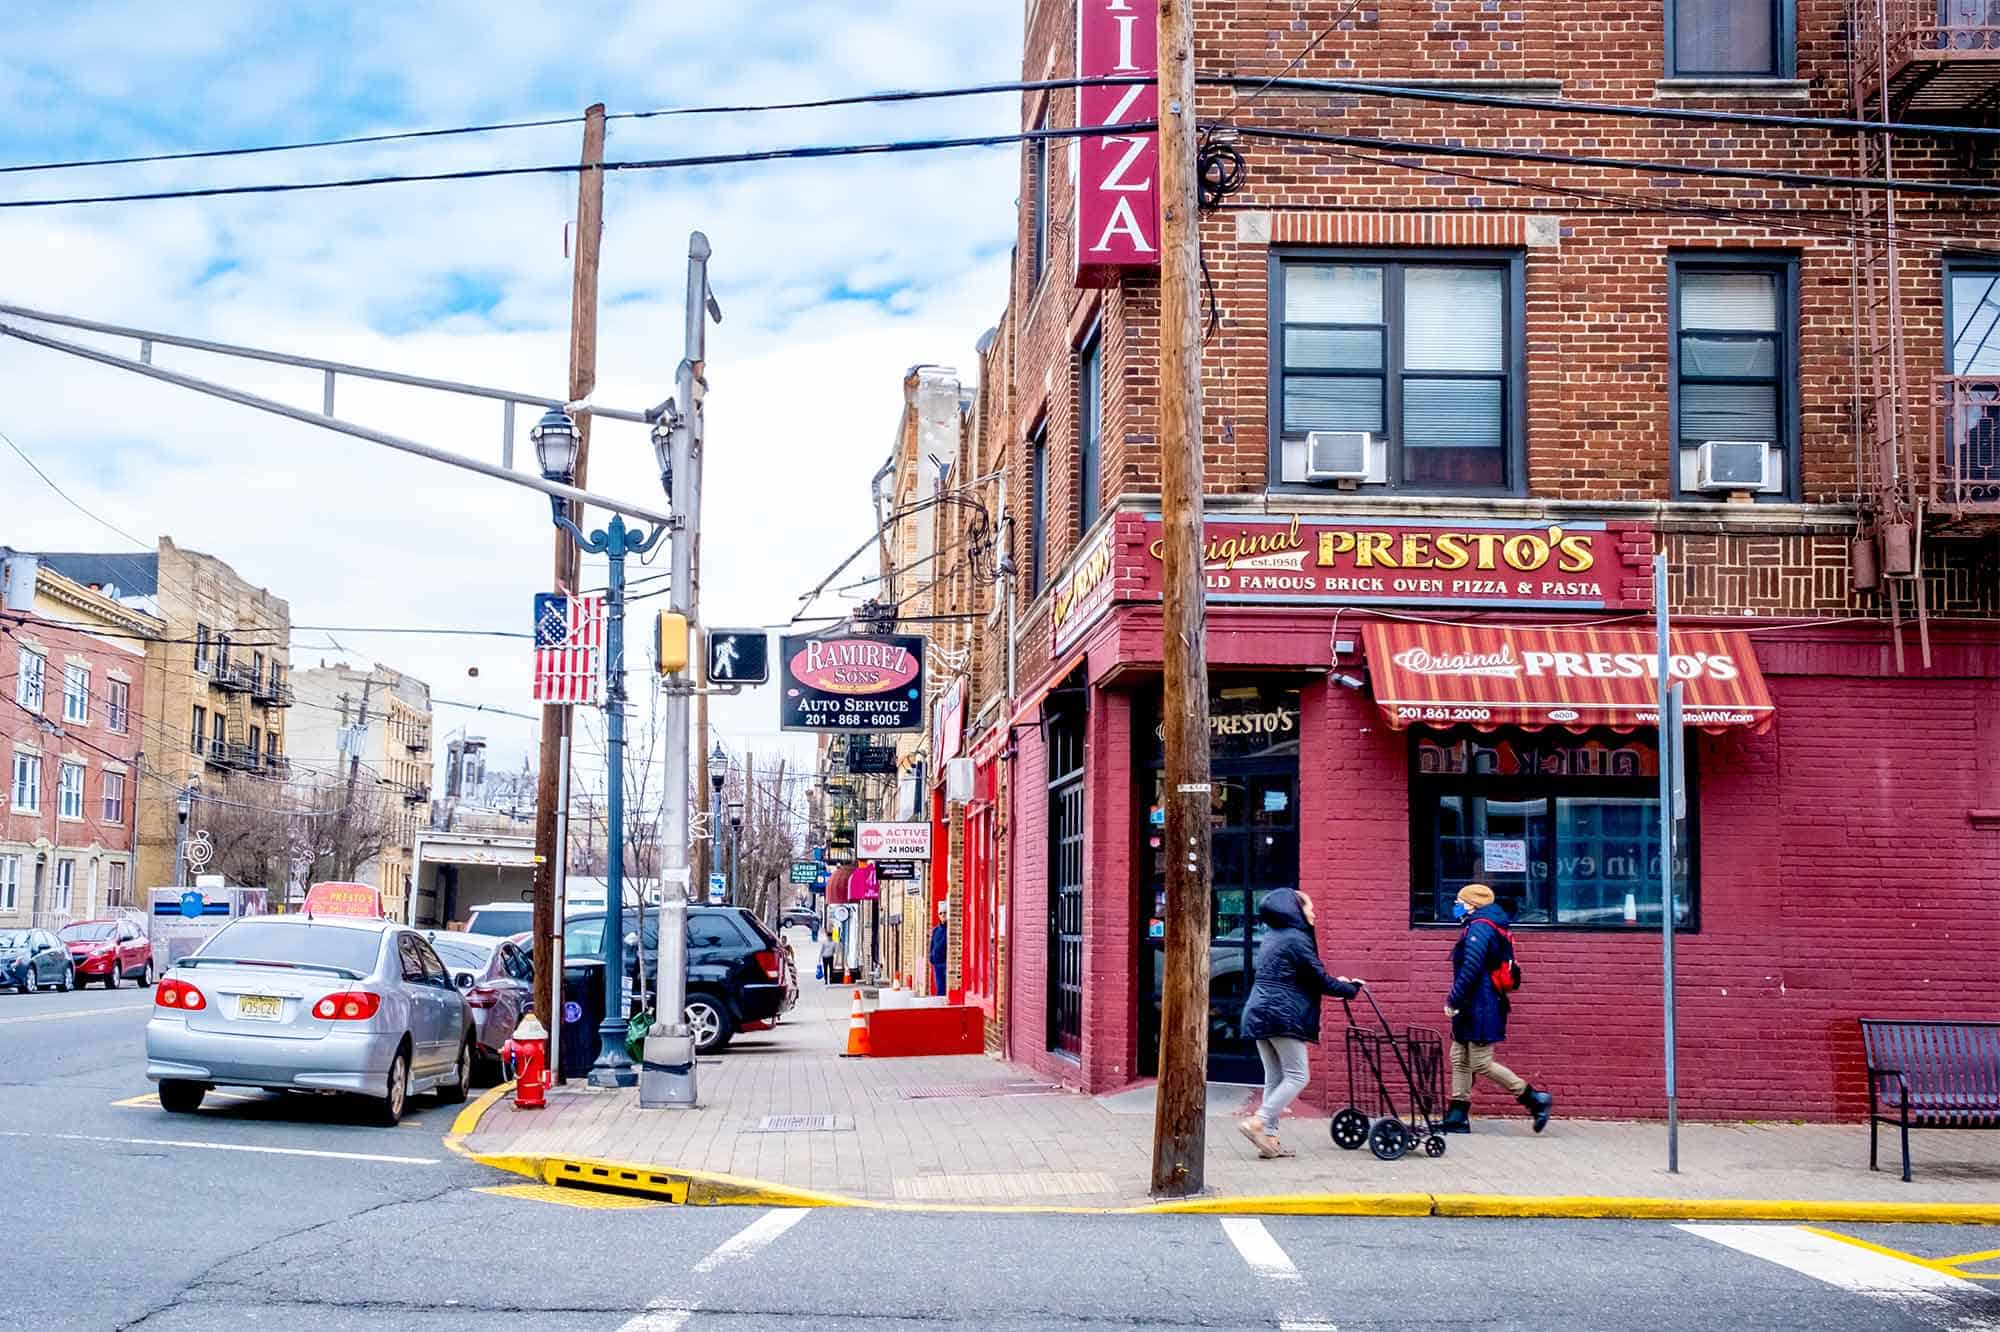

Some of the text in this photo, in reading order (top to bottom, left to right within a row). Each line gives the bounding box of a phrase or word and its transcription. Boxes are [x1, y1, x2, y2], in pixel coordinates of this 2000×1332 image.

[1088, 0, 1158, 252] IZZA
[1315, 525, 1595, 574] PRESTO'S
[1239, 576, 1316, 591] FAMOUS
[1325, 577, 1384, 592] BRICK
[1392, 579, 1443, 593] OVEN
[1452, 580, 1508, 594] PIZZA
[1517, 582, 1533, 595] &
[1541, 582, 1602, 596] PASTA
[805, 639, 907, 674] RAMIREZ
[1393, 645, 1738, 680] Original PRESTO'S
[797, 698, 909, 712] AUTO SERVICE
[1398, 707, 1490, 721] 201.861.2000
[805, 714, 827, 726] 201
[838, 714, 860, 726] 868
[871, 714, 901, 726] 6005
[1207, 706, 1294, 736] PRESTO'S
[886, 828, 929, 837] ACTIVE
[888, 846, 926, 854] 24 HOURS
